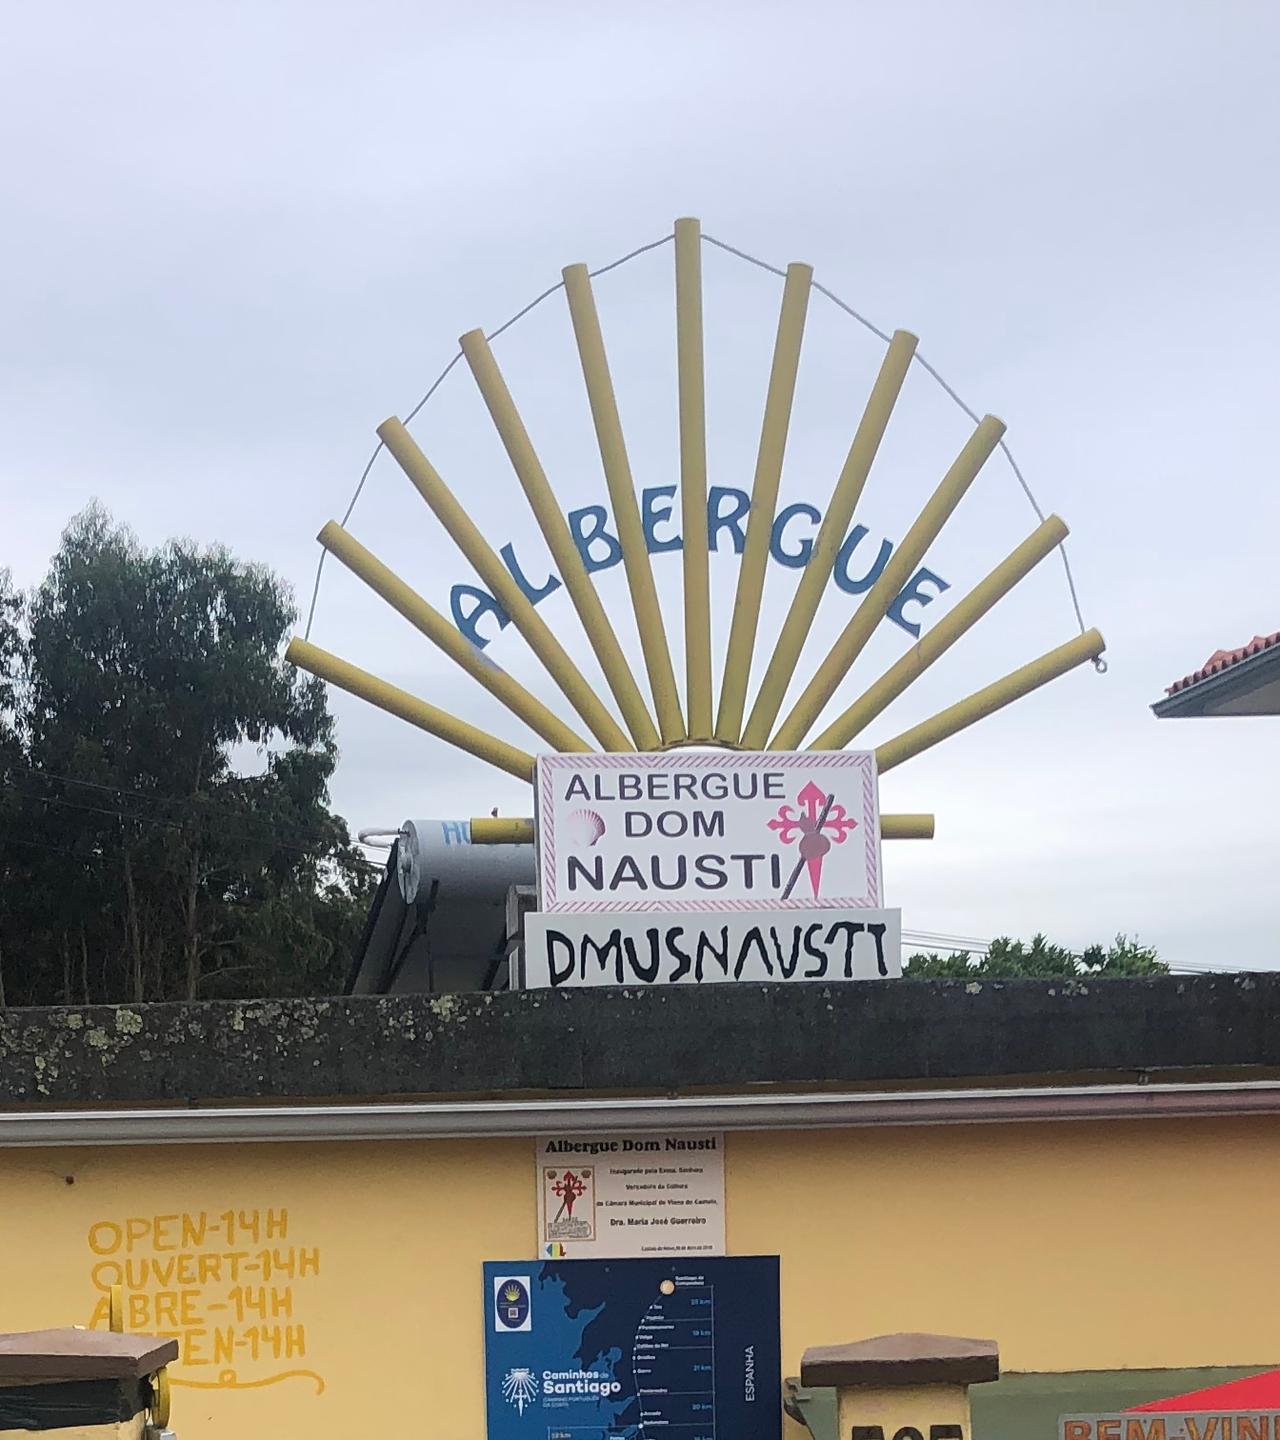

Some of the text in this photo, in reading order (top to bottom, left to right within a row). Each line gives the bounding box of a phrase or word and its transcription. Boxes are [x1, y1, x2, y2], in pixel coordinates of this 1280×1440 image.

[449, 485, 951, 650] ALBERGUE
[564, 772, 787, 801] ALBERGUE
[625, 811, 726, 838] DOM
[567, 854, 781, 891] NAUSTI
[545, 1140, 618, 1154] Albergue
[622, 1139, 660, 1152] Dom
[542, 1369, 599, 1380] Caminhos
[745, 1345, 754, 1401] ESPANHA
[543, 1380, 621, 1396] Santiago
